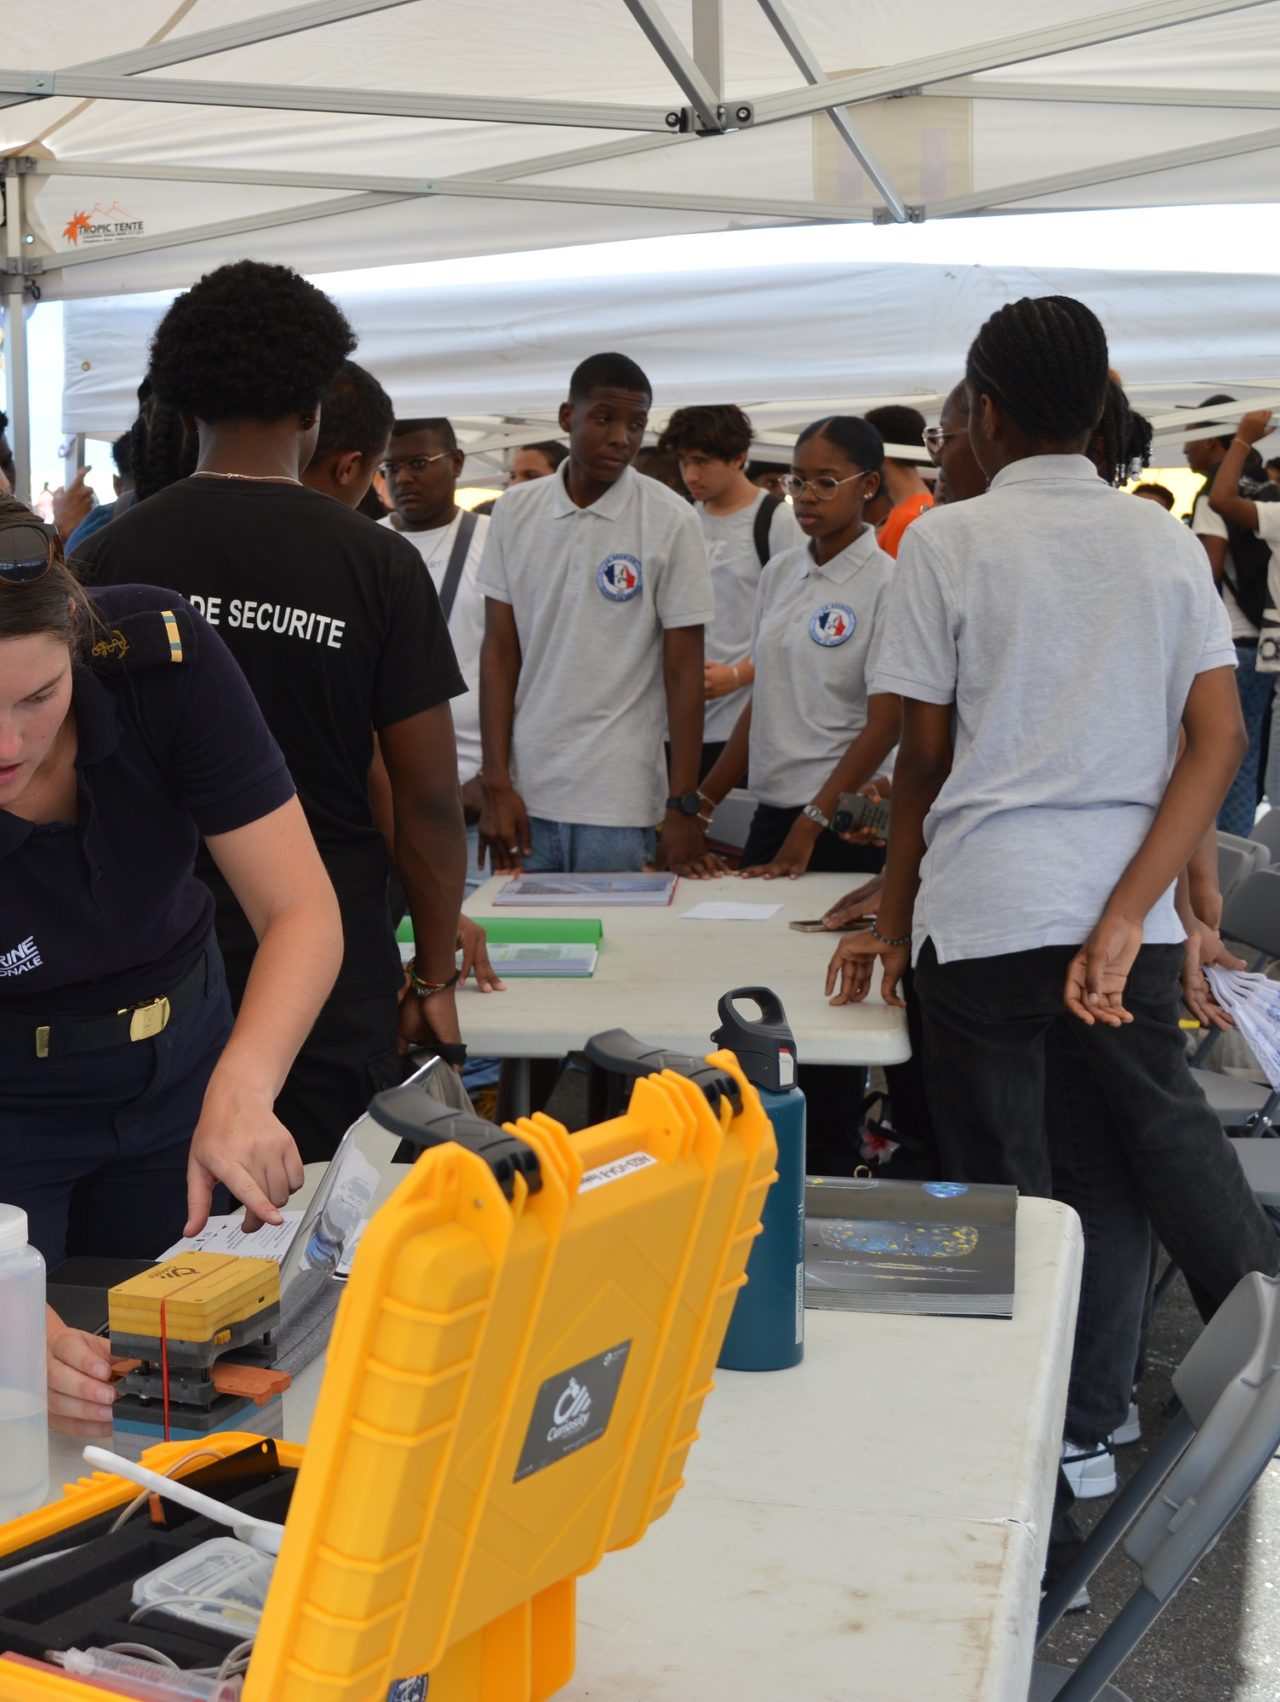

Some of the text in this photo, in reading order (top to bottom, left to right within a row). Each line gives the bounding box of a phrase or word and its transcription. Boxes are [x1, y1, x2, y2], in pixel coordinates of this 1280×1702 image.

[78, 223, 112, 235] TROPIC
[114, 221, 144, 231] TENTE
[189, 594, 346, 649] DE SECURITE
